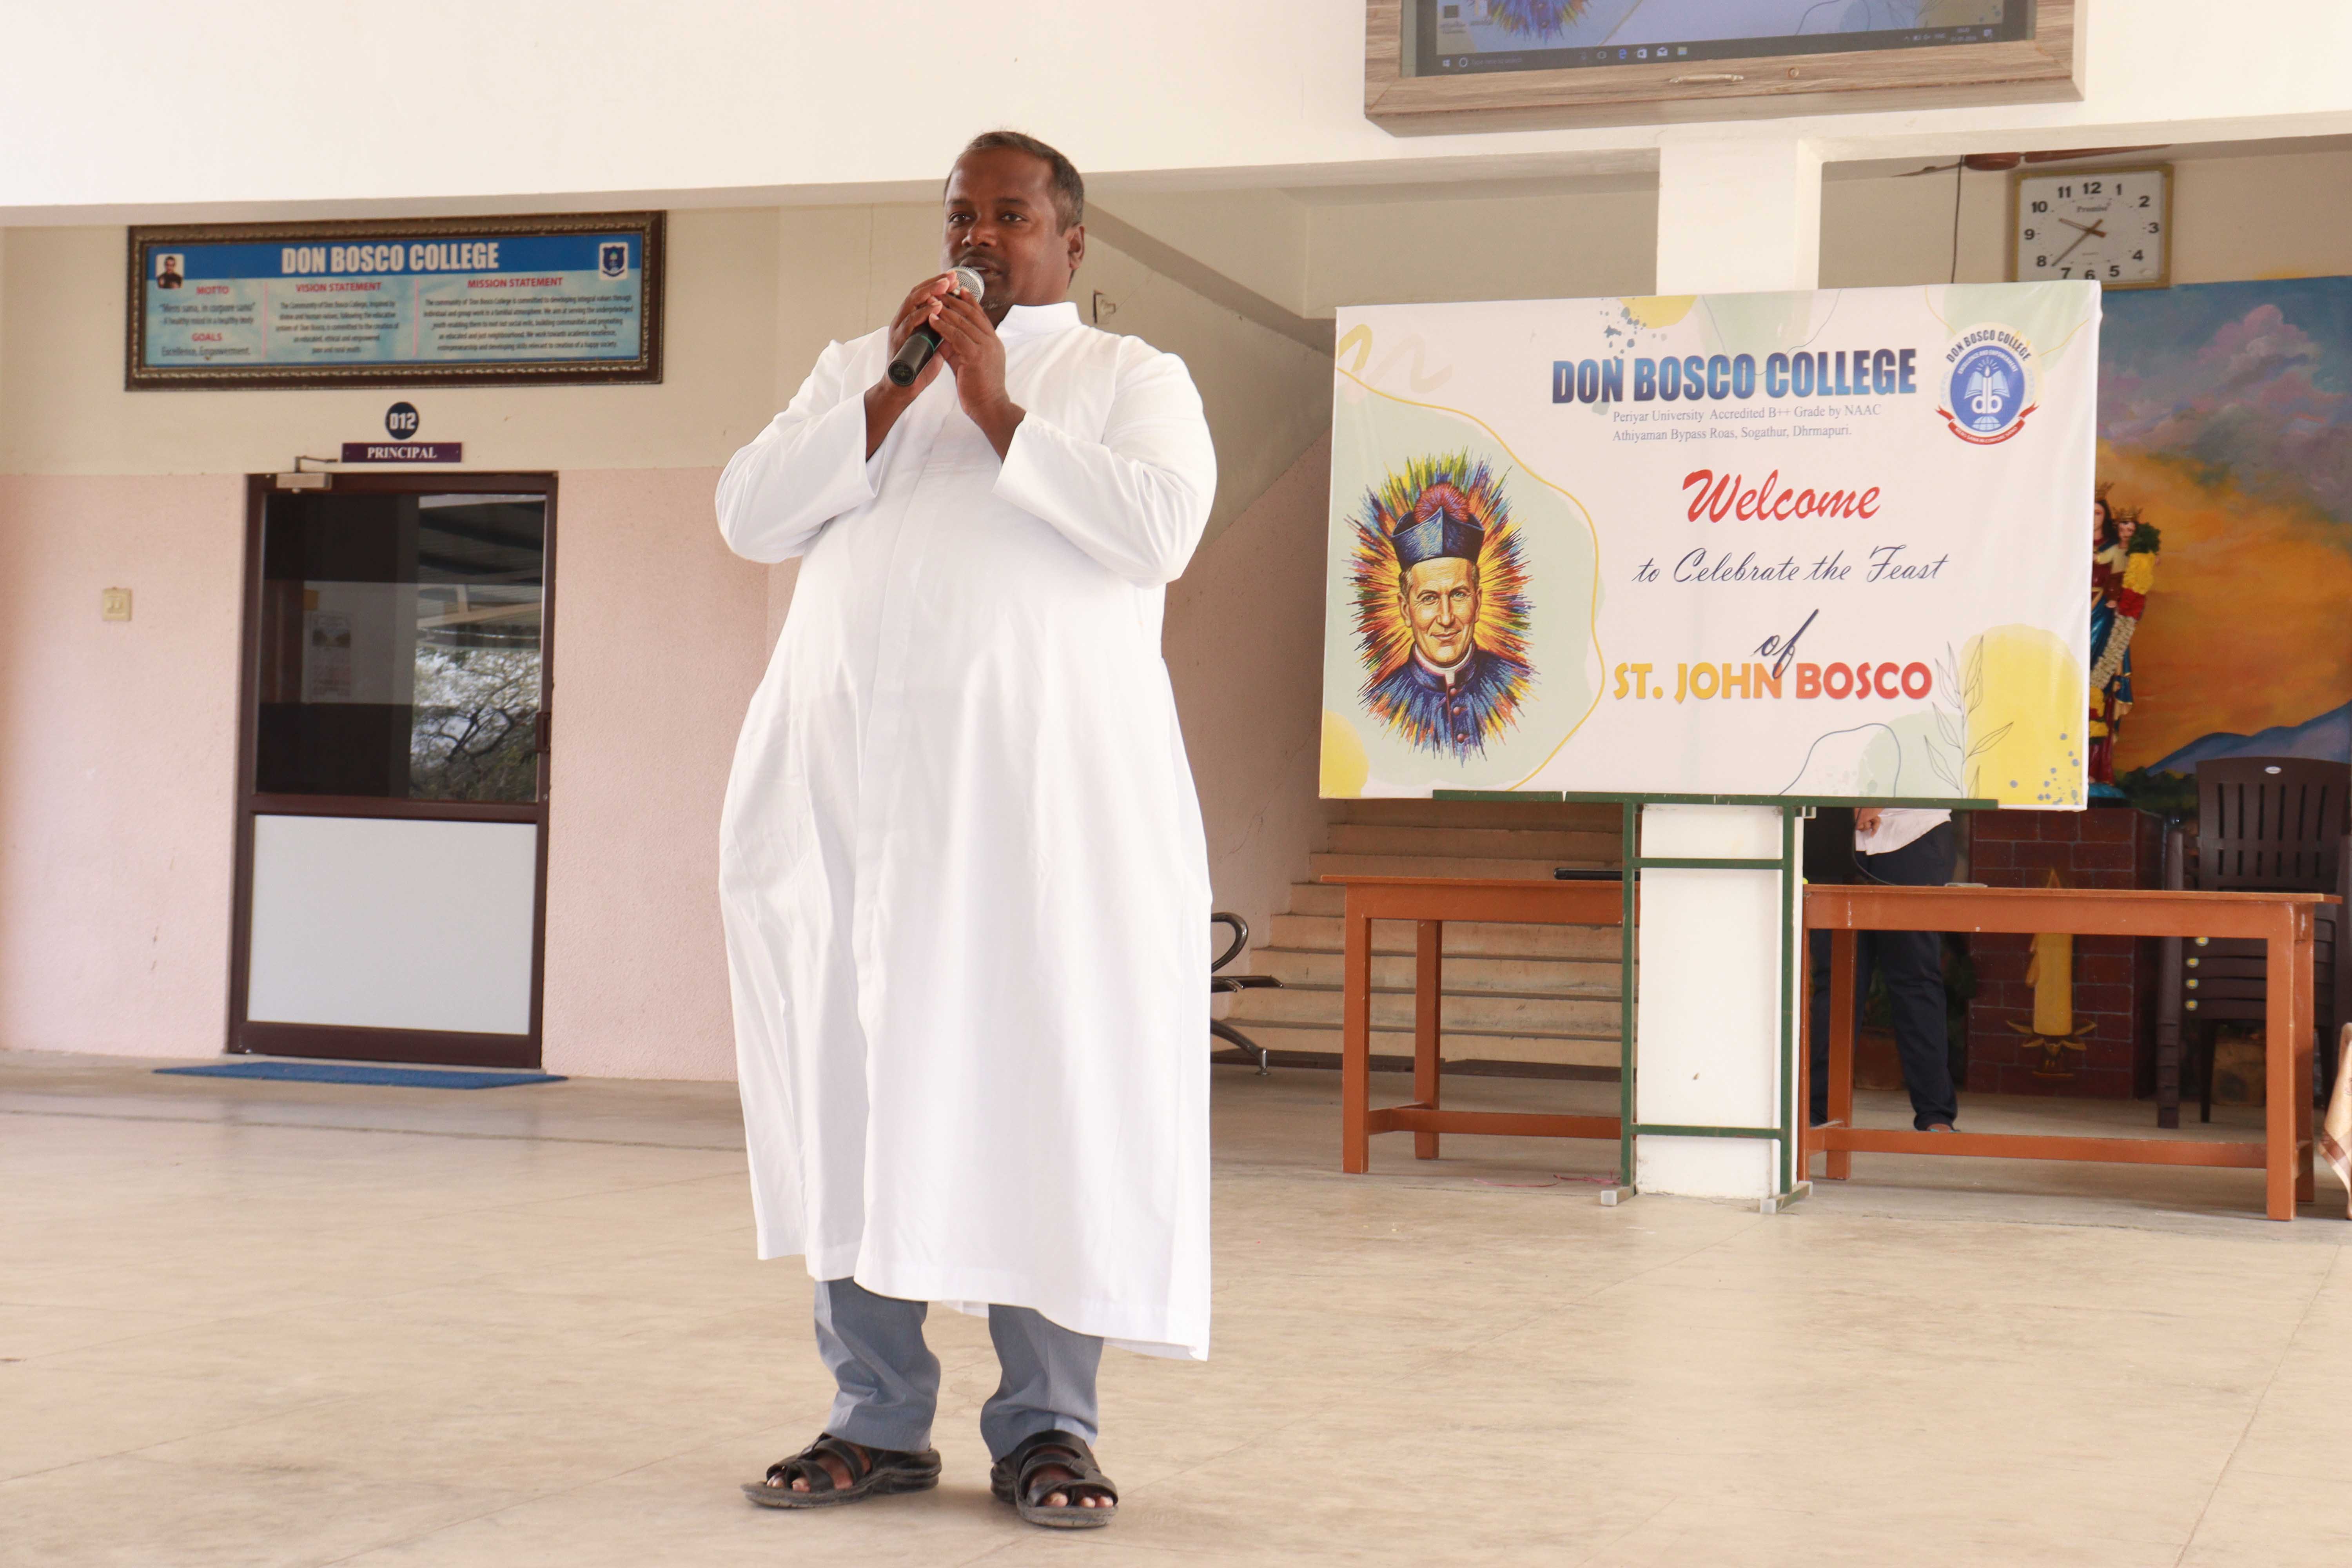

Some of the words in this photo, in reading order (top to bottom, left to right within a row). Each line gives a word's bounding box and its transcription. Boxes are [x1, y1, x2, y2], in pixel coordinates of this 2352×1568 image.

[2058, 186, 2071, 198] 11
[2083, 182, 2102, 194] 12
[2116, 183, 2122, 195] 1
[2032, 201, 2048, 213] 10
[2139, 196, 2151, 208] 2
[2148, 222, 2159, 234] 3
[2024, 229, 2035, 240] 9
[282, 247, 326, 274] DON
[330, 244, 404, 274] BOSCO
[409, 241, 499, 271] COLLEGE
[2036, 256, 2047, 267] 8
[2132, 250, 2143, 261] 4
[2060, 267, 2071, 279] 7
[2084, 270, 2096, 280] 6
[2109, 265, 2120, 277] 5
[296, 282, 327, 292] VISION
[329, 281, 382, 291] STATEMENT
[468, 279, 507, 288] MISSION
[509, 277, 563, 288] STATEMENT
[197, 286, 230, 294] MOTTO
[192, 333, 223, 341] GOALS
[1946, 342, 1965, 363] DON
[1964, 330, 1996, 347] BOSCO
[1998, 331, 2032, 361] COLLEGE
[1552, 358, 1624, 404] DON
[1633, 354, 1756, 401] BOSCO
[1766, 348, 1916, 398] COLLEGE
[1613, 410, 1649, 424] Periyar
[1652, 408, 1704, 422] University
[1710, 407, 1765, 420] Accredited
[1768, 407, 1791, 418] B++
[1794, 405, 1825, 417] Grade
[1829, 404, 1840, 419] by
[1844, 403, 1881, 416] NAAC
[389, 412, 416, 430] 012
[1612, 430, 1668, 443] Athiyaman
[1670, 428, 1706, 442] Bypass
[1710, 427, 1738, 439] Roas,
[1741, 425, 1789, 440] Sogathur,
[1793, 424, 1852, 438] Dhrmapuri.
[367, 446, 437, 459] PRINCIPAL
[1682, 469, 1881, 523] Welcome
[1632, 557, 1661, 582] to
[1673, 547, 1800, 583] Celebrate
[1803, 550, 1851, 581] the
[1866, 544, 1949, 583] Feast
[1749, 609, 1819, 679] of
[1613, 662, 1664, 700] ST.
[1675, 662, 1783, 704] JOHN
[1796, 661, 1933, 700] BOSCO
